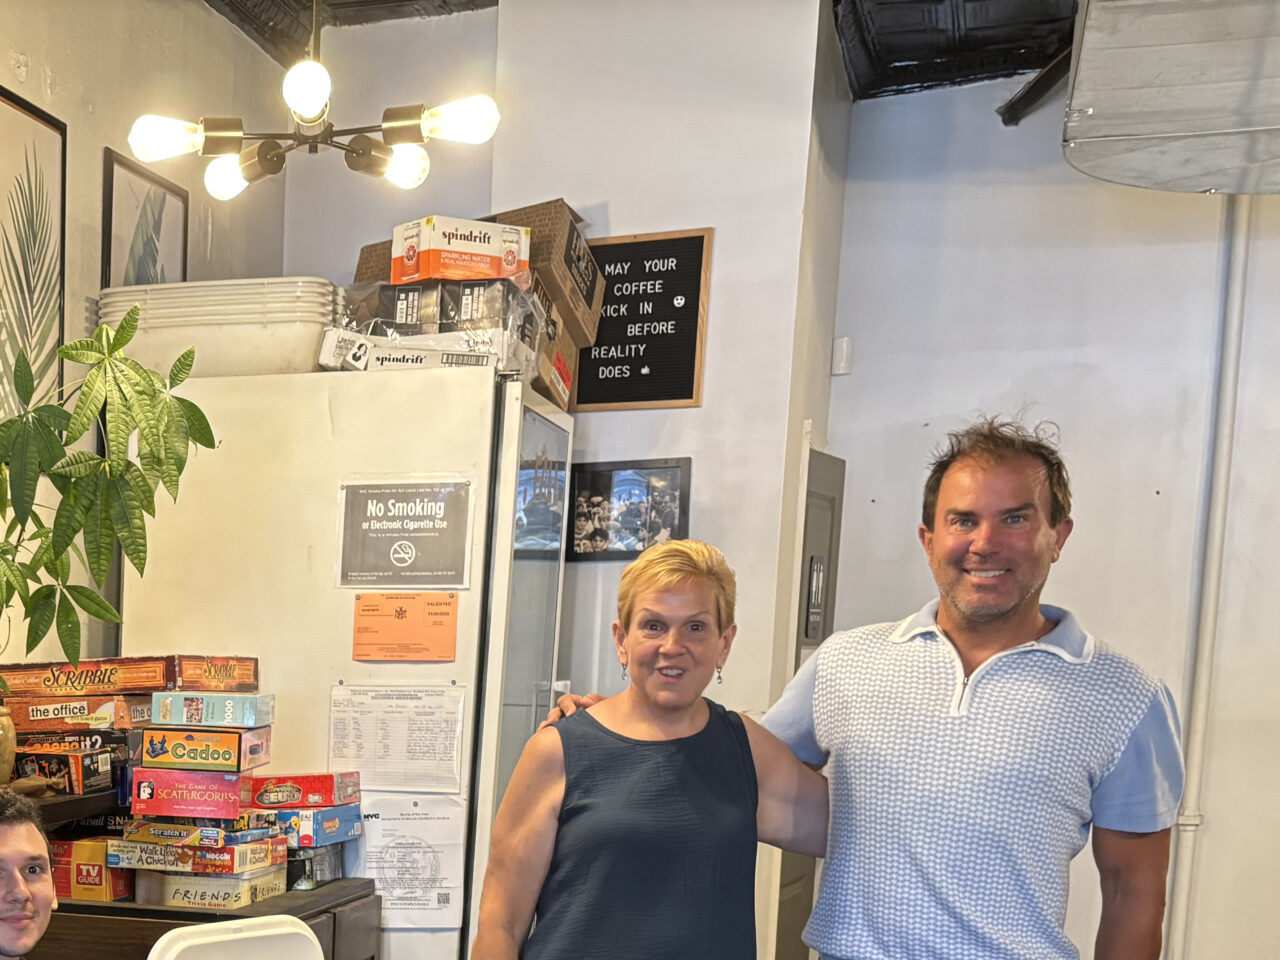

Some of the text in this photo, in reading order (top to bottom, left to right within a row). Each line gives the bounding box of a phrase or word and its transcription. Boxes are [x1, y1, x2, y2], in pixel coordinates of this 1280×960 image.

[442, 228, 491, 245] spindrift
[605, 258, 676, 275] MAY YOUR
[614, 281, 663, 295] COFFEE
[639, 302, 652, 315] IN
[628, 321, 675, 336] BEFORE
[591, 345, 646, 359] REALITY
[376, 355, 424, 364] spindrift
[599, 366, 630, 378] DOES
[367, 499, 444, 518] No Smoking
[371, 519, 402, 529] Electronic
[404, 520, 433, 530] Cigarette
[435, 520, 447, 528] Use
[43, 664, 118, 691] SCRABBLE
[32, 704, 85, 718] the office
[132, 707, 145, 718] the
[171, 743, 233, 762] Cadoo
[158, 789, 239, 802] SCATTERGORIES
[149, 827, 177, 837] Scratch
[139, 845, 159, 854] Walk
[207, 852, 231, 860] NOGGIN
[137, 856, 178, 867] A Chicken
[80, 865, 99, 876] TV
[78, 876, 100, 884] GUIDE
